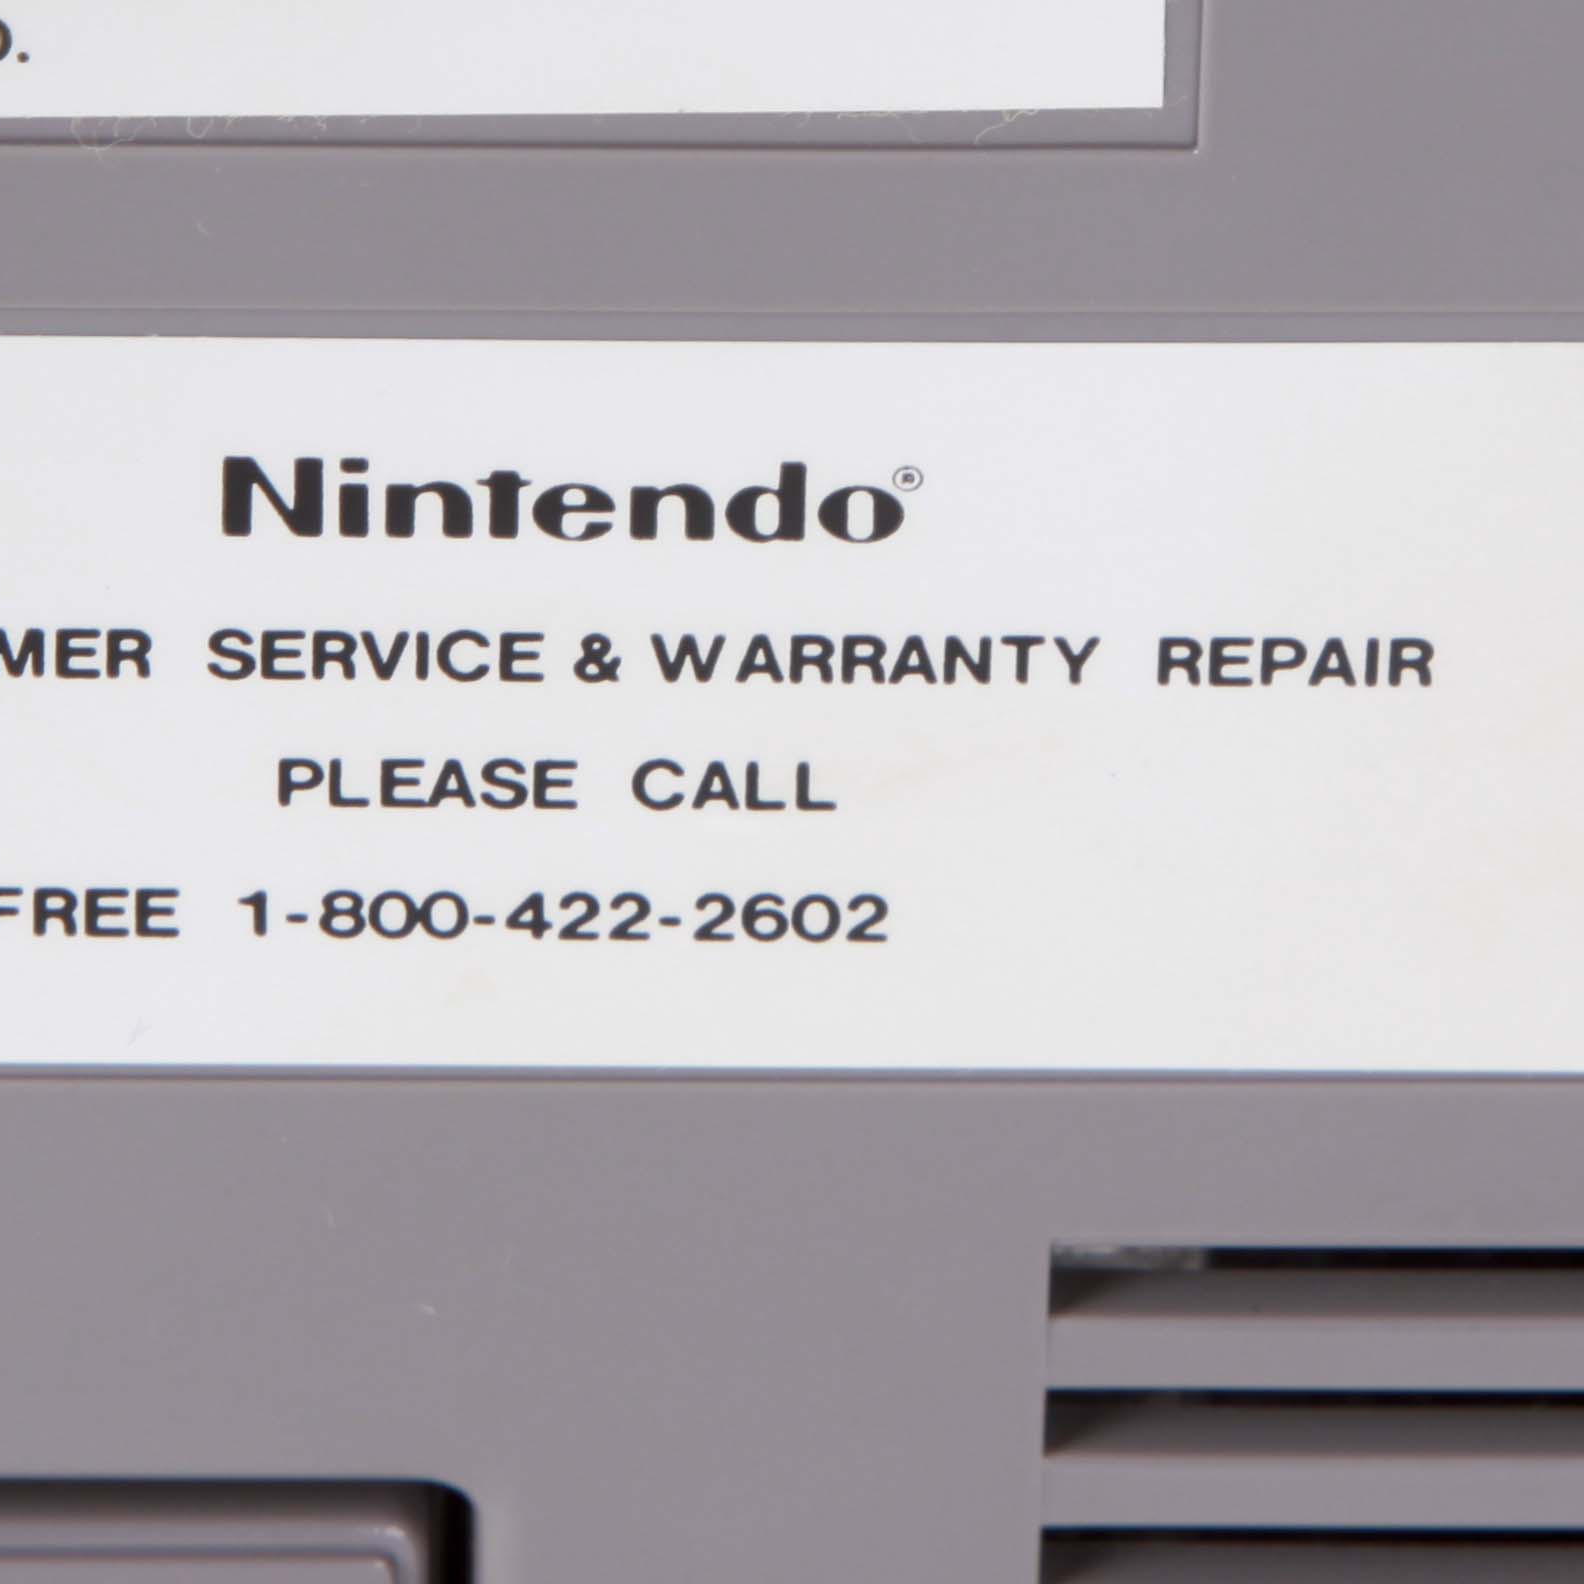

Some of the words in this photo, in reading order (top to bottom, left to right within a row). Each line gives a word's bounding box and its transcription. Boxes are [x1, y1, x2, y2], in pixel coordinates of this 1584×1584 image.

[208, 628, 544, 682] SERVICE
[573, 633, 621, 683] &
[651, 634, 1099, 684] WARRANTY
[1157, 637, 1434, 687] REPAIR
[278, 758, 577, 810] PLEASE
[632, 759, 836, 811] CALL
[239, 890, 888, 942] 1-800-422-2602
